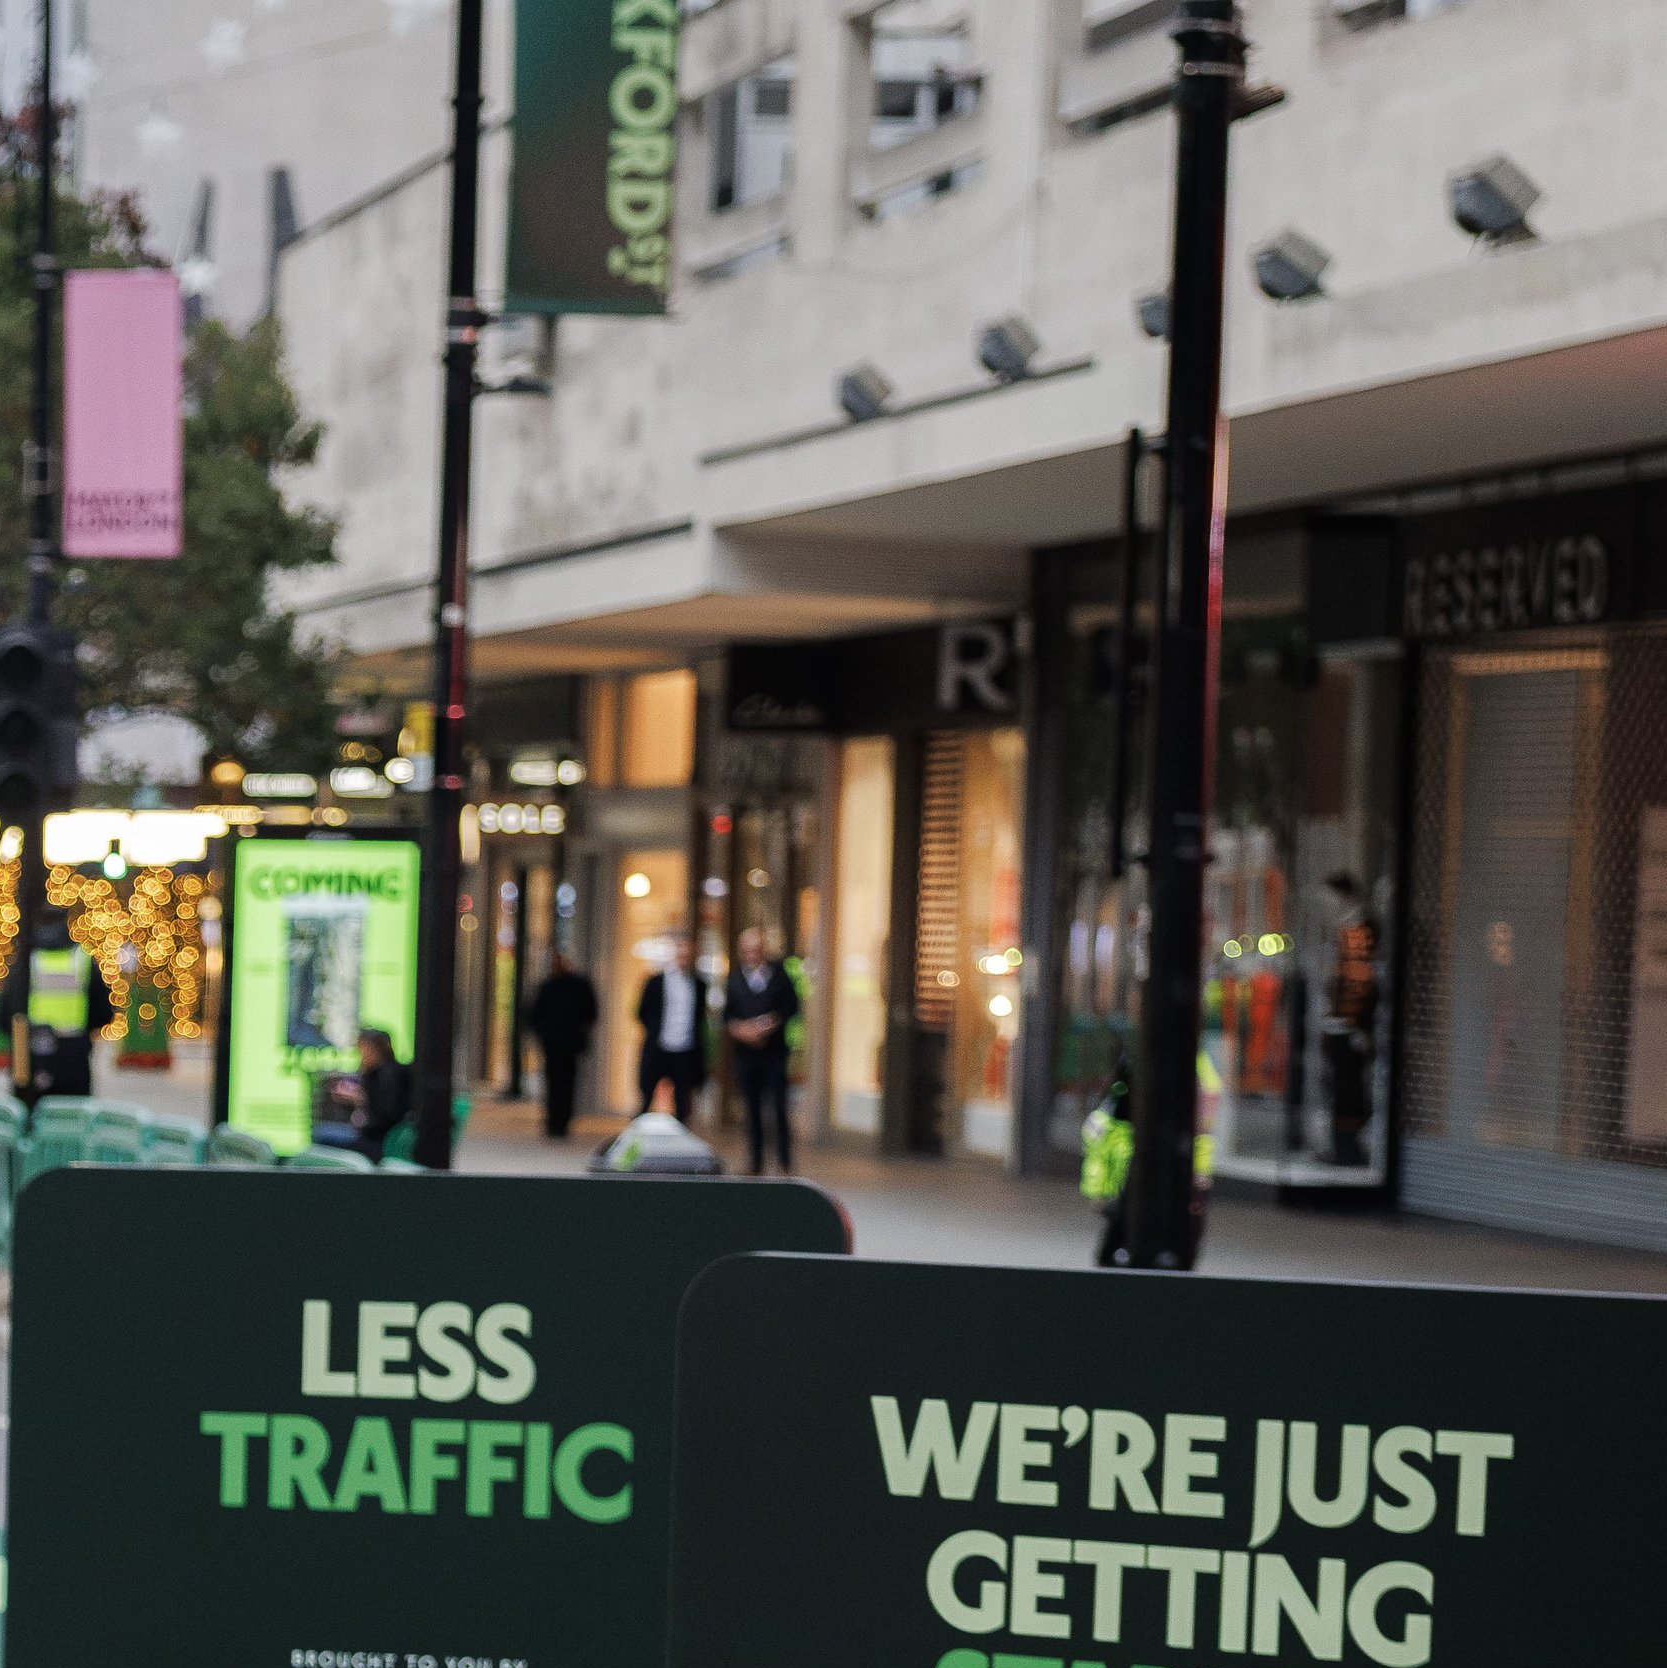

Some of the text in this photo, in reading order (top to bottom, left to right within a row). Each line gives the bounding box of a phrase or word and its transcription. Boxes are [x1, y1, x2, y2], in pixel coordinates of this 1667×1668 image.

[302, 1299, 536, 1404] LESS
[200, 1411, 634, 1523] TRAFFIC
[1248, 1419, 1514, 1548] JUST
[927, 1530, 1433, 1668] GETTING
